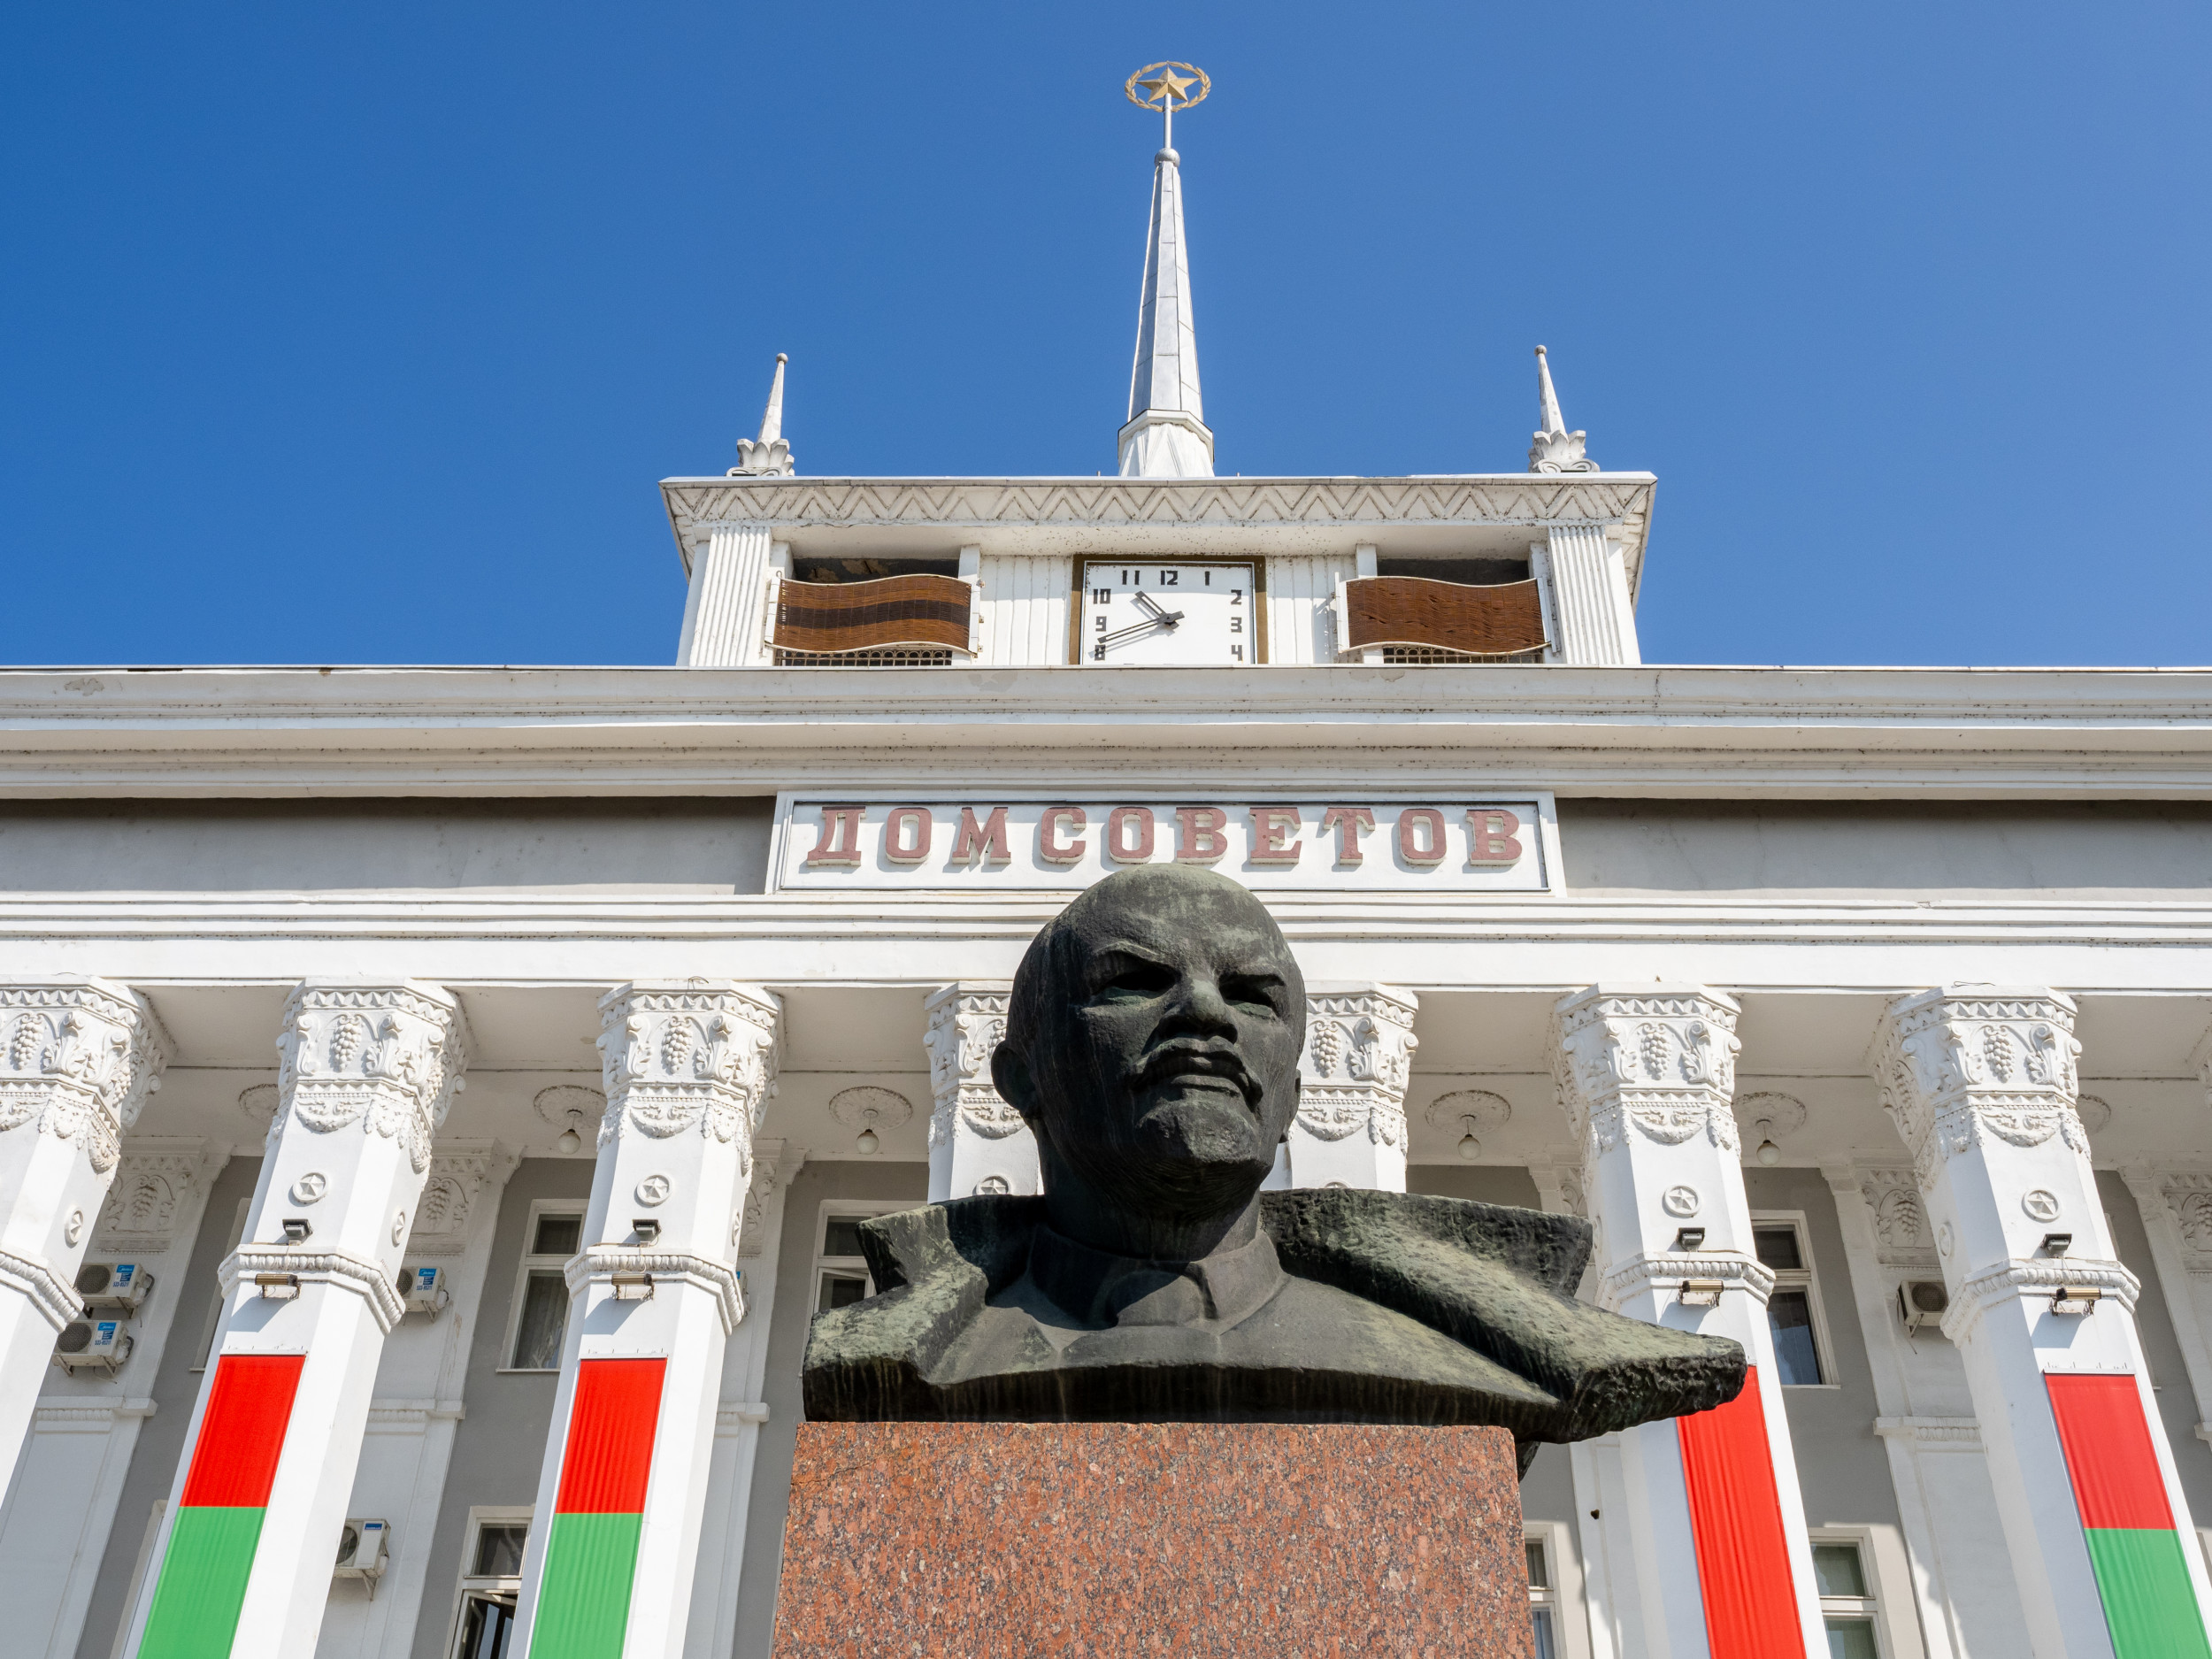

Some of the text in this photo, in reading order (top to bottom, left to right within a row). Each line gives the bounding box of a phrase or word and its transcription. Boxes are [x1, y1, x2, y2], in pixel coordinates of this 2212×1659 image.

[1122, 570, 1210, 586] 11 12 1
[1093, 588, 1111, 604] 10
[1231, 589, 1242, 605] 2
[1095, 616, 1107, 632] 9
[1231, 617, 1242, 633] 3
[1094, 644, 1106, 661] 8
[1231, 644, 1242, 661] 4
[806, 806, 1523, 866] ДОМ СОВЕТОВ
